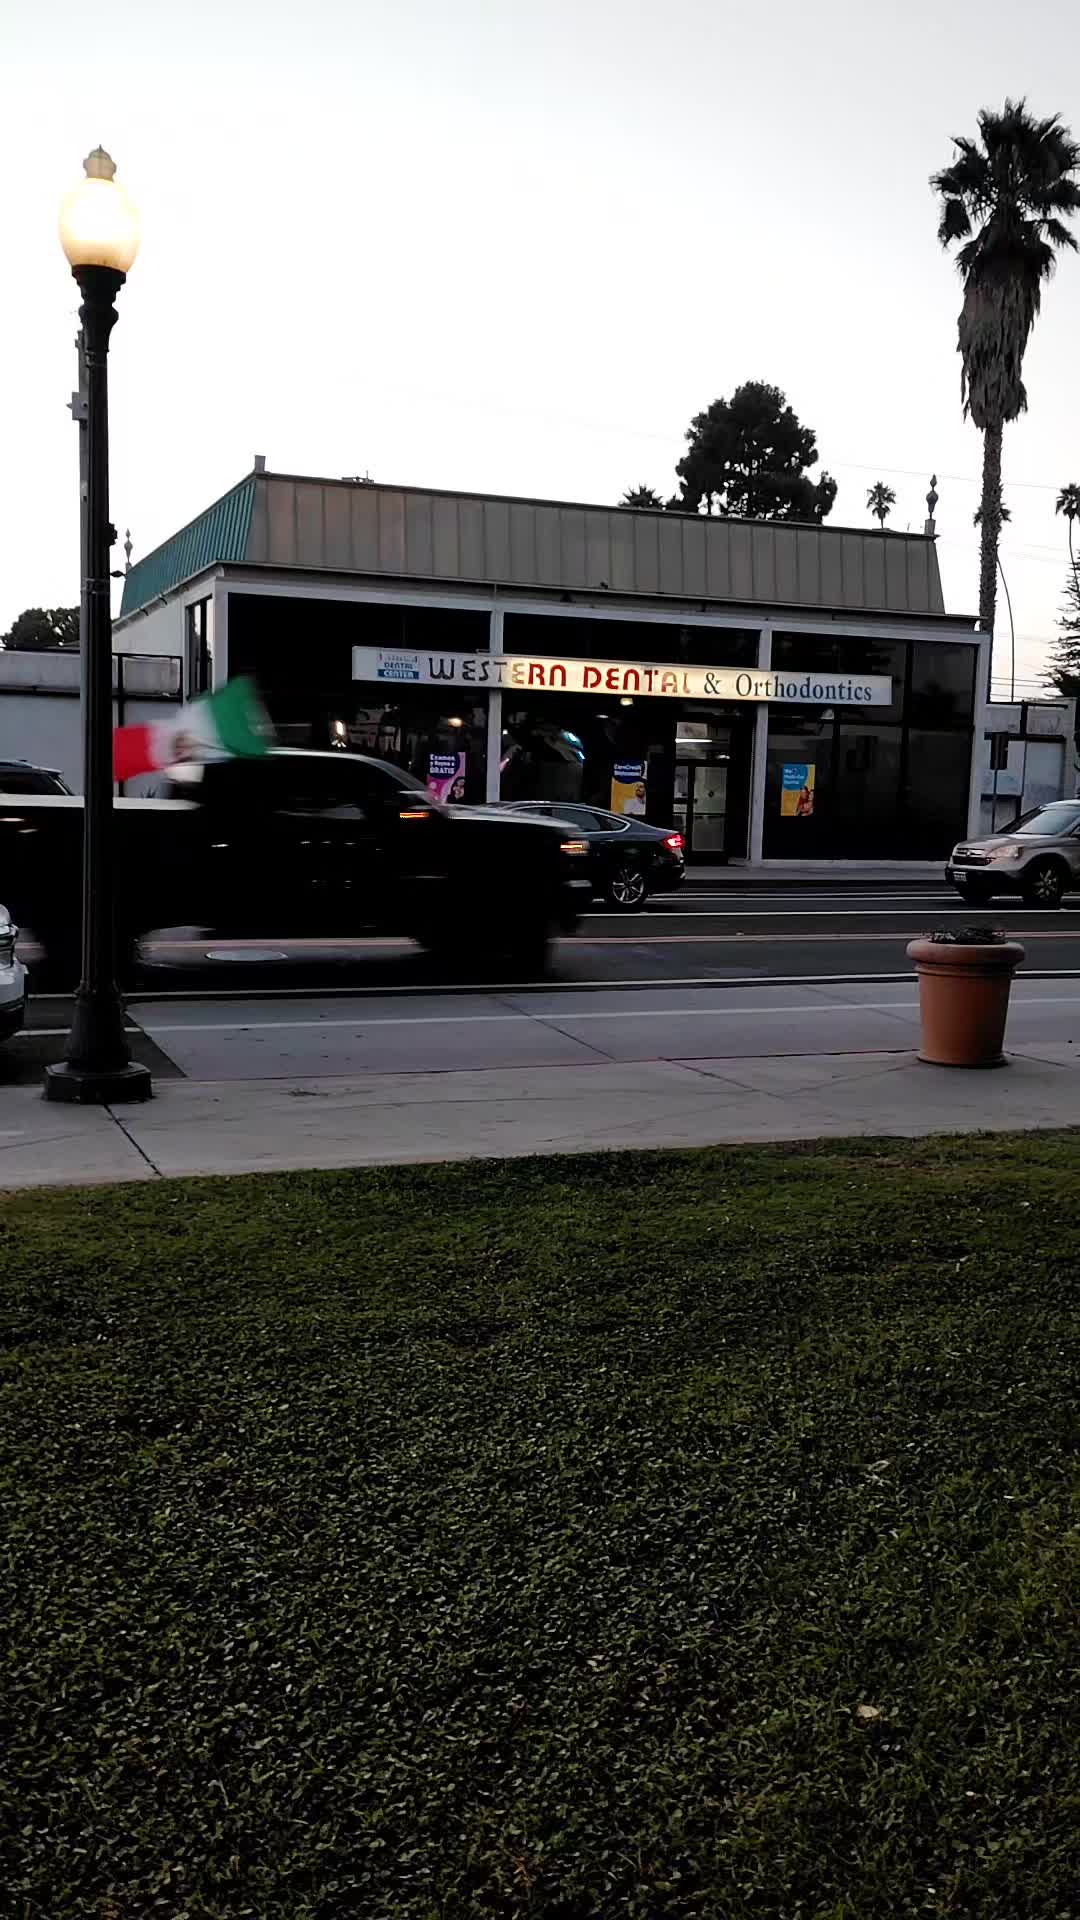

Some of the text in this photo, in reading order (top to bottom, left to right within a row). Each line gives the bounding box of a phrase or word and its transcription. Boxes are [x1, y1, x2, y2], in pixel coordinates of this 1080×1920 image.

[429, 657, 872, 701] WESTERN DENTAL & Orthodontics
